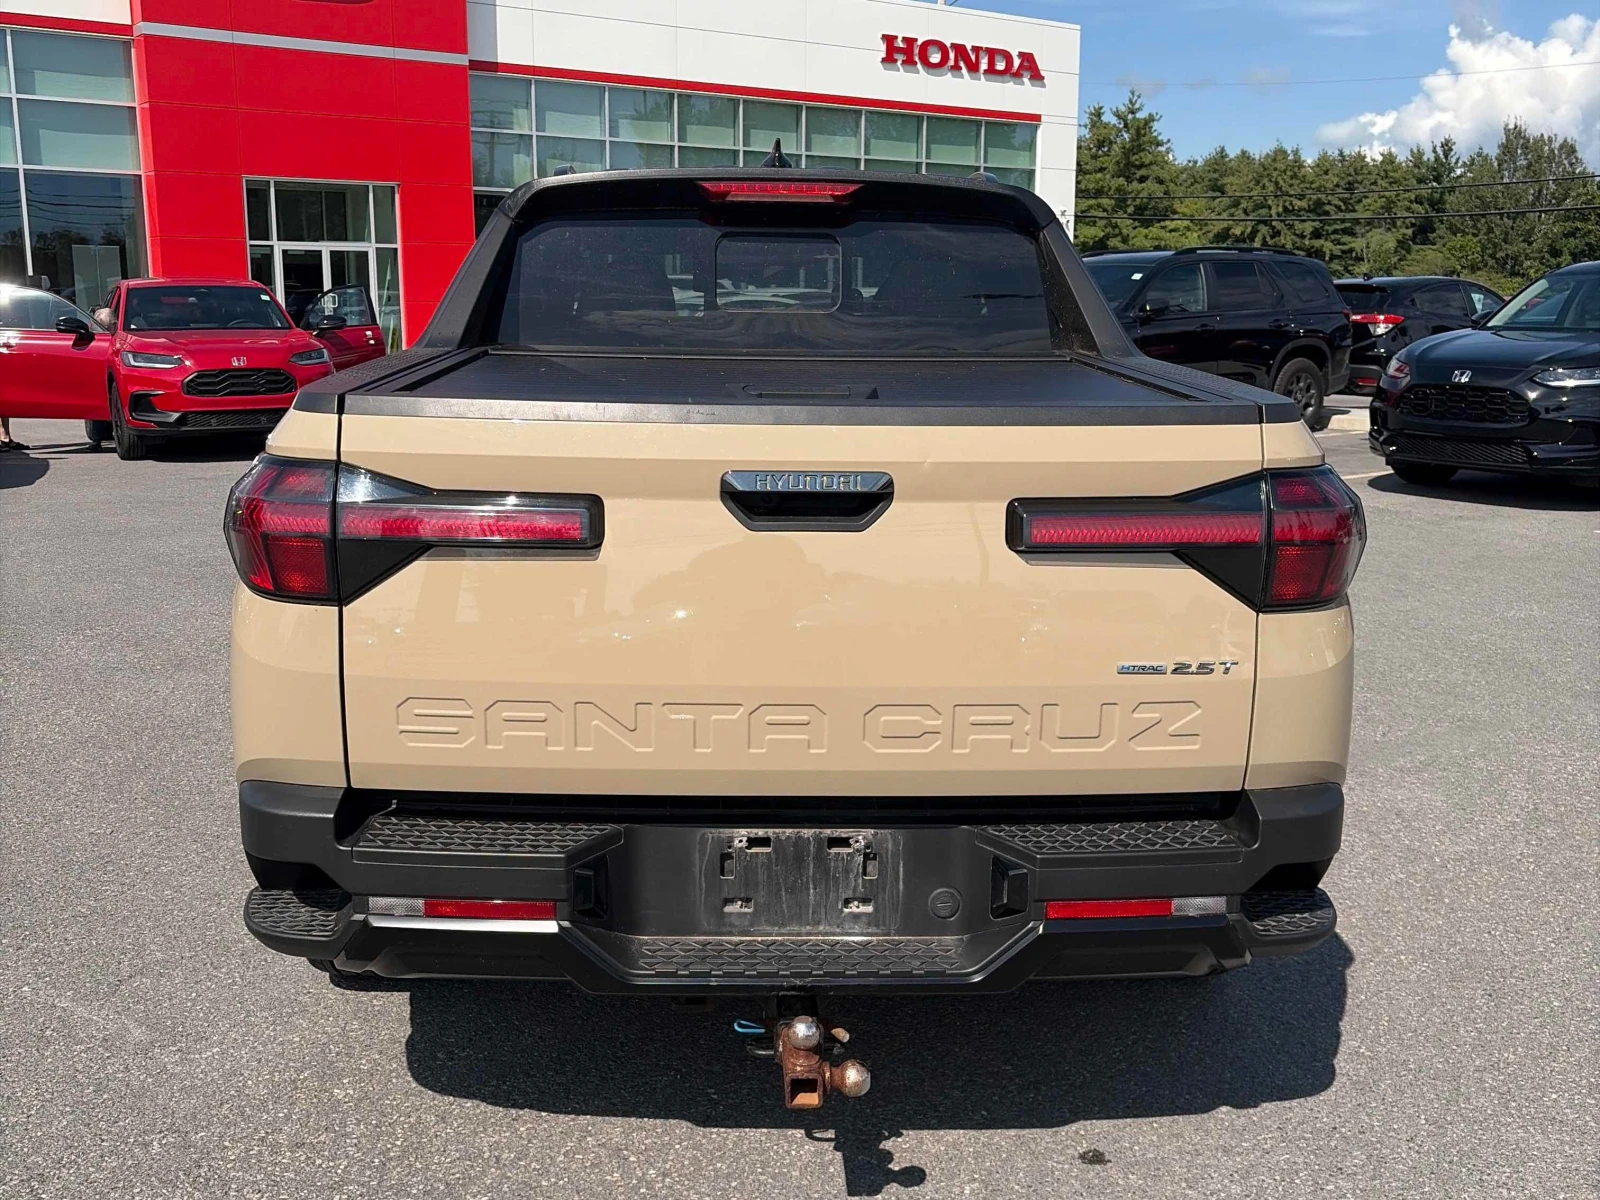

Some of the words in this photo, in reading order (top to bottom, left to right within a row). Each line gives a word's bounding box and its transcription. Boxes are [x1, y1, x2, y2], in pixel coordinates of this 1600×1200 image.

[880, 33, 1045, 81] HONDA
[755, 473, 862, 491] HYUNDAI
[1119, 664, 1164, 673] HTRAC
[396, 696, 828, 753] SANTA
[863, 700, 1202, 753] CRUZ
